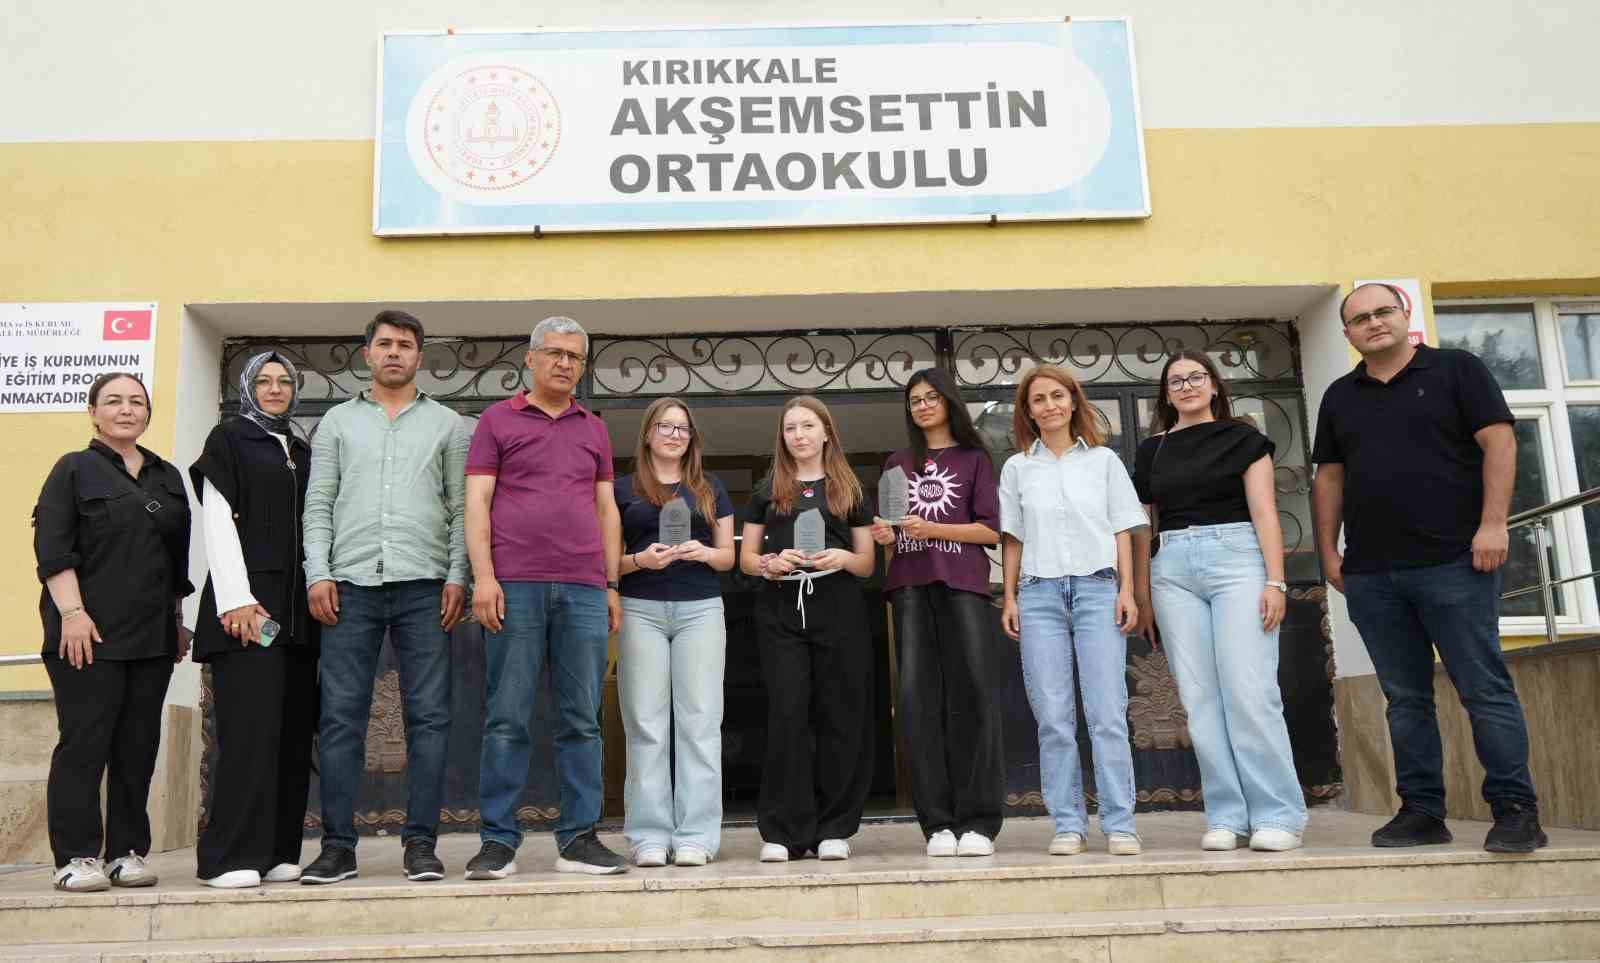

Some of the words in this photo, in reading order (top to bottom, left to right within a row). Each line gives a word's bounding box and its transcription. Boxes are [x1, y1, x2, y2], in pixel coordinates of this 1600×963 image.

[623, 58, 837, 85] KIRIKKALE
[610, 82, 1047, 145] AKŞEMSETTİN
[609, 148, 988, 194] ORTAOKULU
[24, 352, 38, 371] İŞ
[43, 354, 140, 368] KURUMUNUN
[5, 370, 56, 386] EĞİTİM
